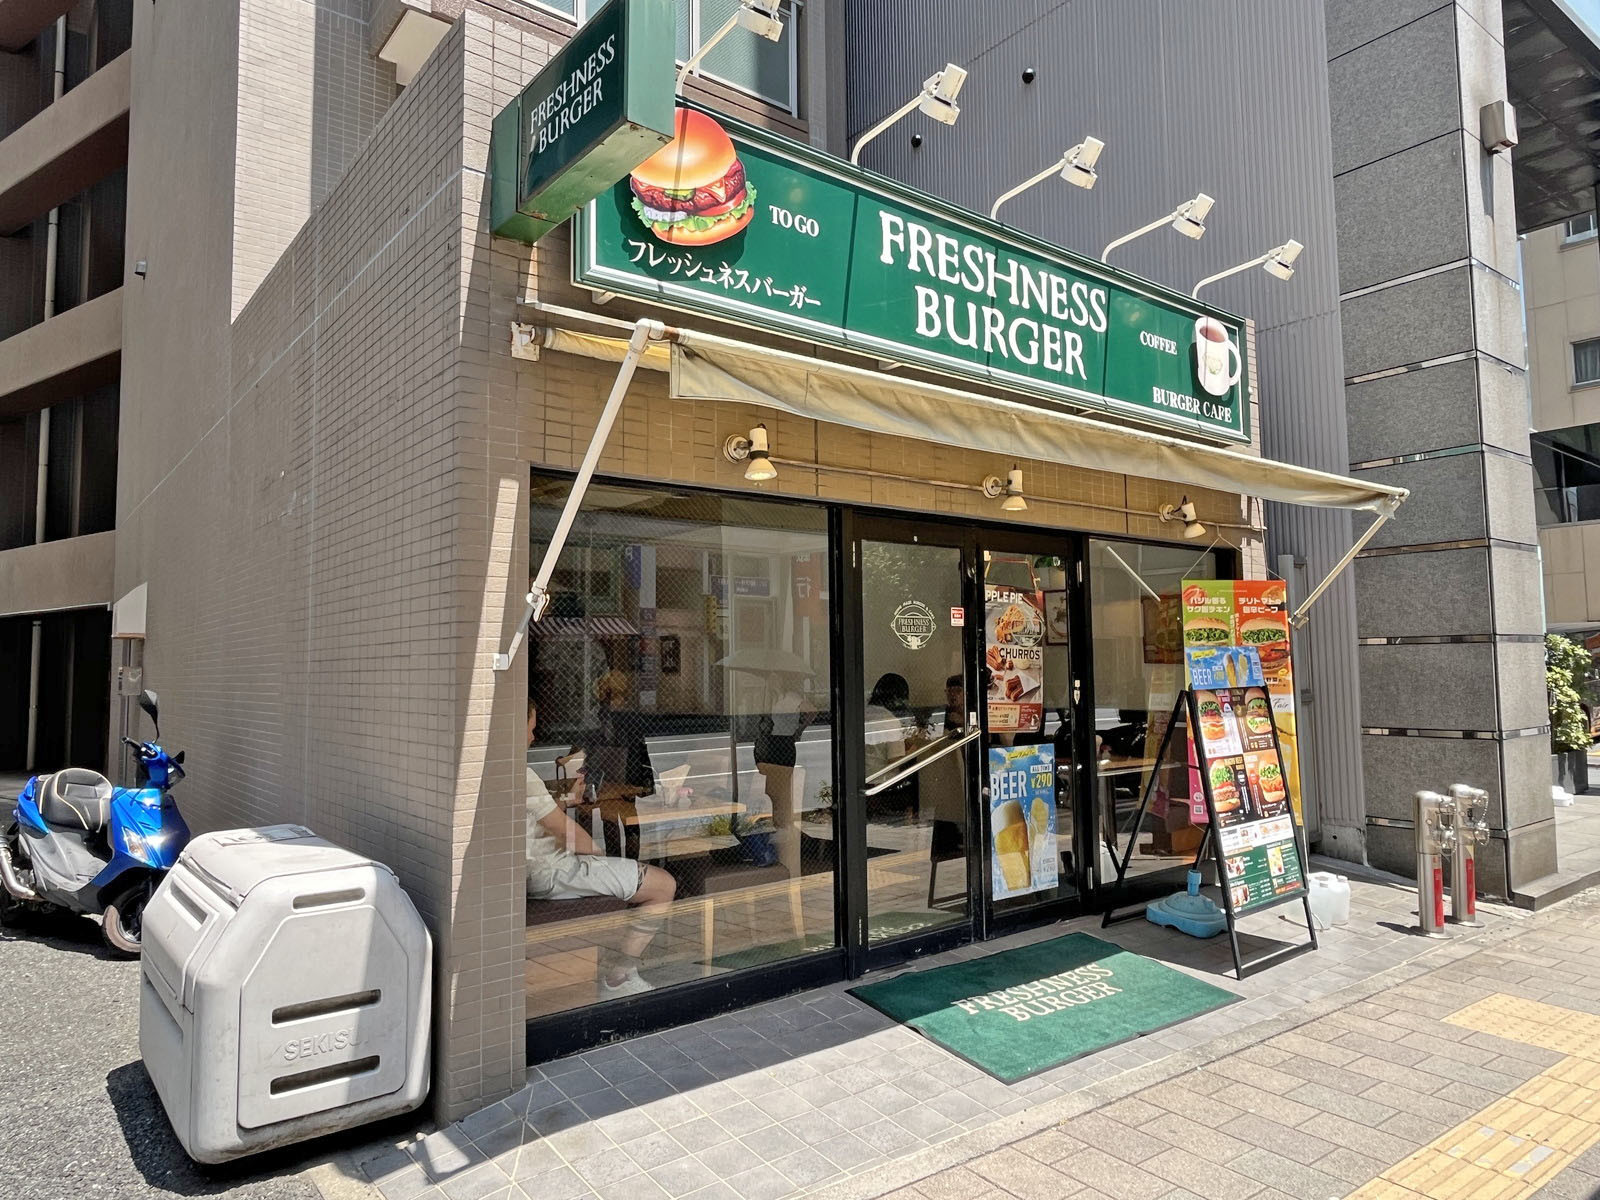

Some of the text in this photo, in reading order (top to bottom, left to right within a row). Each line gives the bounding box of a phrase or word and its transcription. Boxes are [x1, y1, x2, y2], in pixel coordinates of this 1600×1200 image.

[530, 34, 616, 135] FRESHNESS
[537, 77, 604, 154] BURGER
[769, 204, 820, 238] TO GO
[628, 238, 822, 310] フレッシュネスバーガー
[879, 209, 1109, 333] FRESHNESS
[914, 284, 1088, 381] BURGER
[1139, 329, 1178, 356] COFFEE
[1152, 386, 1233, 423] BURGER CAFE
[985, 590, 1024, 605] PPLE PIE
[999, 647, 1041, 661] CHURROS
[1192, 668, 1213, 686] BEER
[990, 770, 1028, 801] BEER
[1031, 772, 1053, 789] ¥290
[950, 962, 1115, 1015] FRESHNESS
[998, 981, 1123, 1022] BURGER
